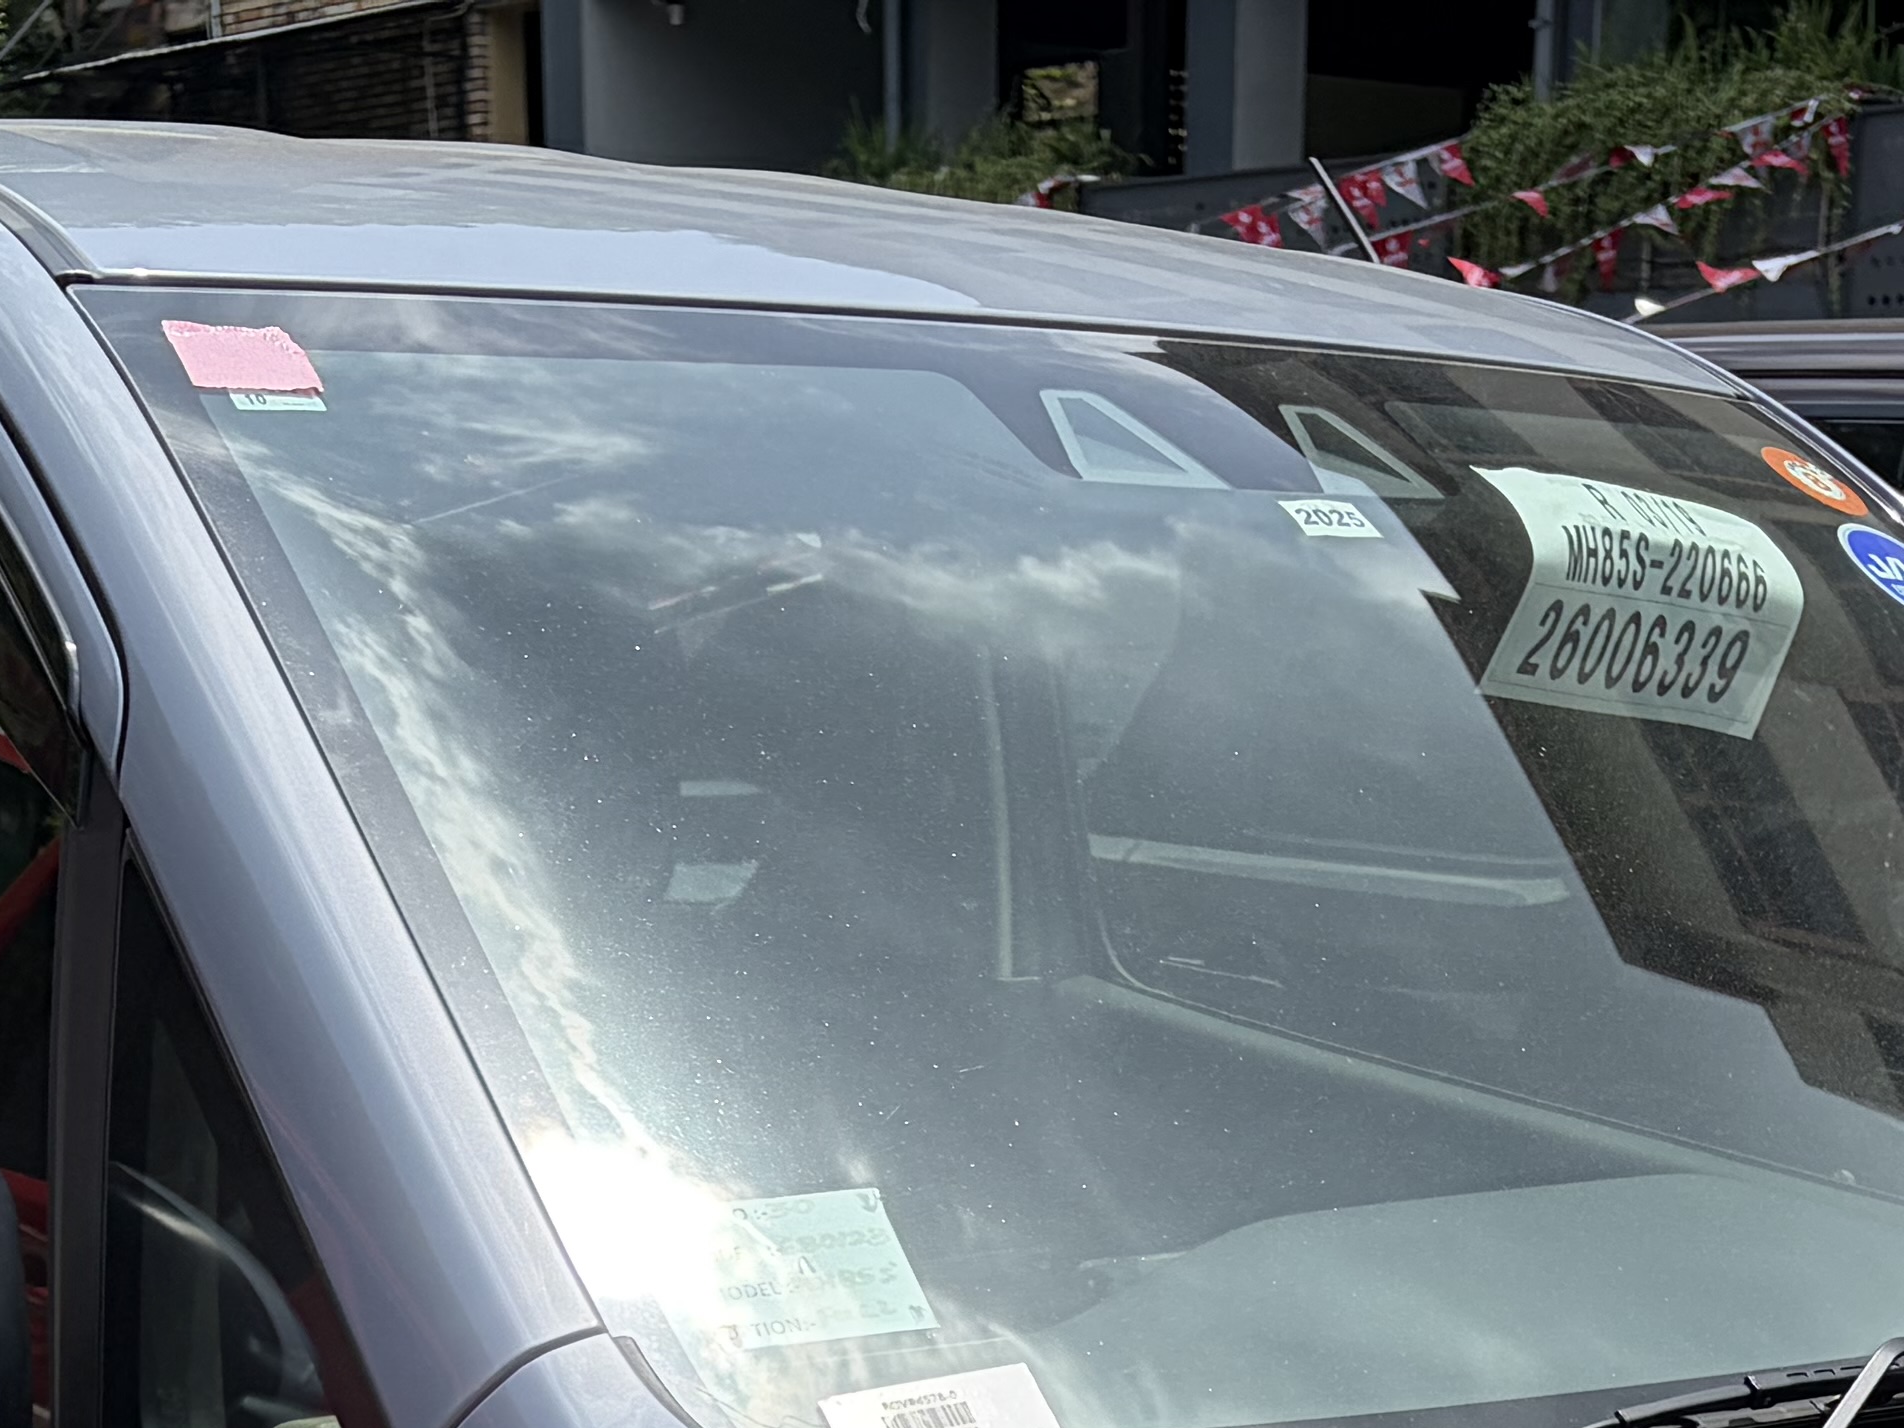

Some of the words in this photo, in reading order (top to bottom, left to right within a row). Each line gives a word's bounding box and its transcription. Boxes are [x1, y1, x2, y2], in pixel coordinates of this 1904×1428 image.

[1295, 507, 1365, 529] 2025
[1582, 483, 1627, 521] R
[1562, 524, 1767, 613] MH85S-220666
[1516, 599, 1750, 704] 26006339
